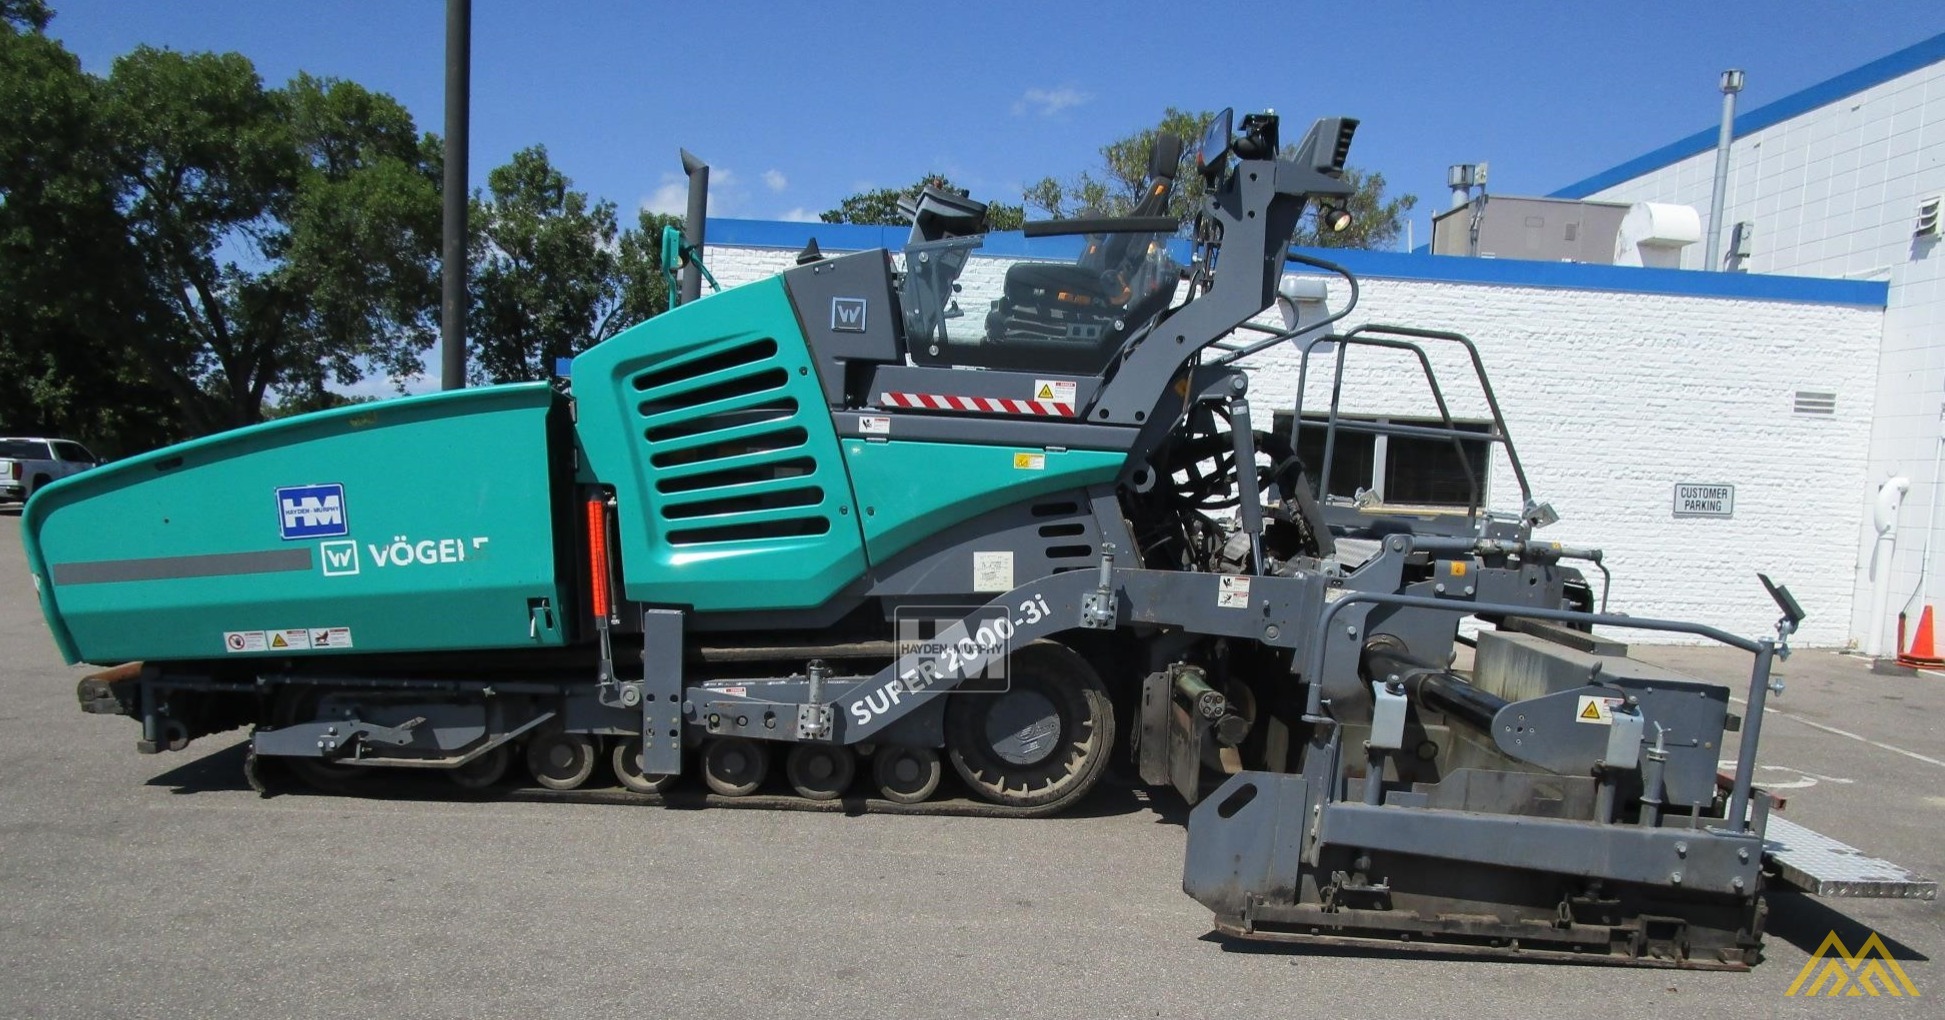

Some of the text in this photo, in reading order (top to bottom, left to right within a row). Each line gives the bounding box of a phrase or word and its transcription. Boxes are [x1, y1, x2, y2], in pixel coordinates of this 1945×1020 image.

[1681, 487, 1728, 499] CUSTOMER
[1685, 500, 1722, 511] PARKING
[368, 535, 489, 567] VÖGEL
[850, 593, 1051, 725] SUPER 2000-3i
